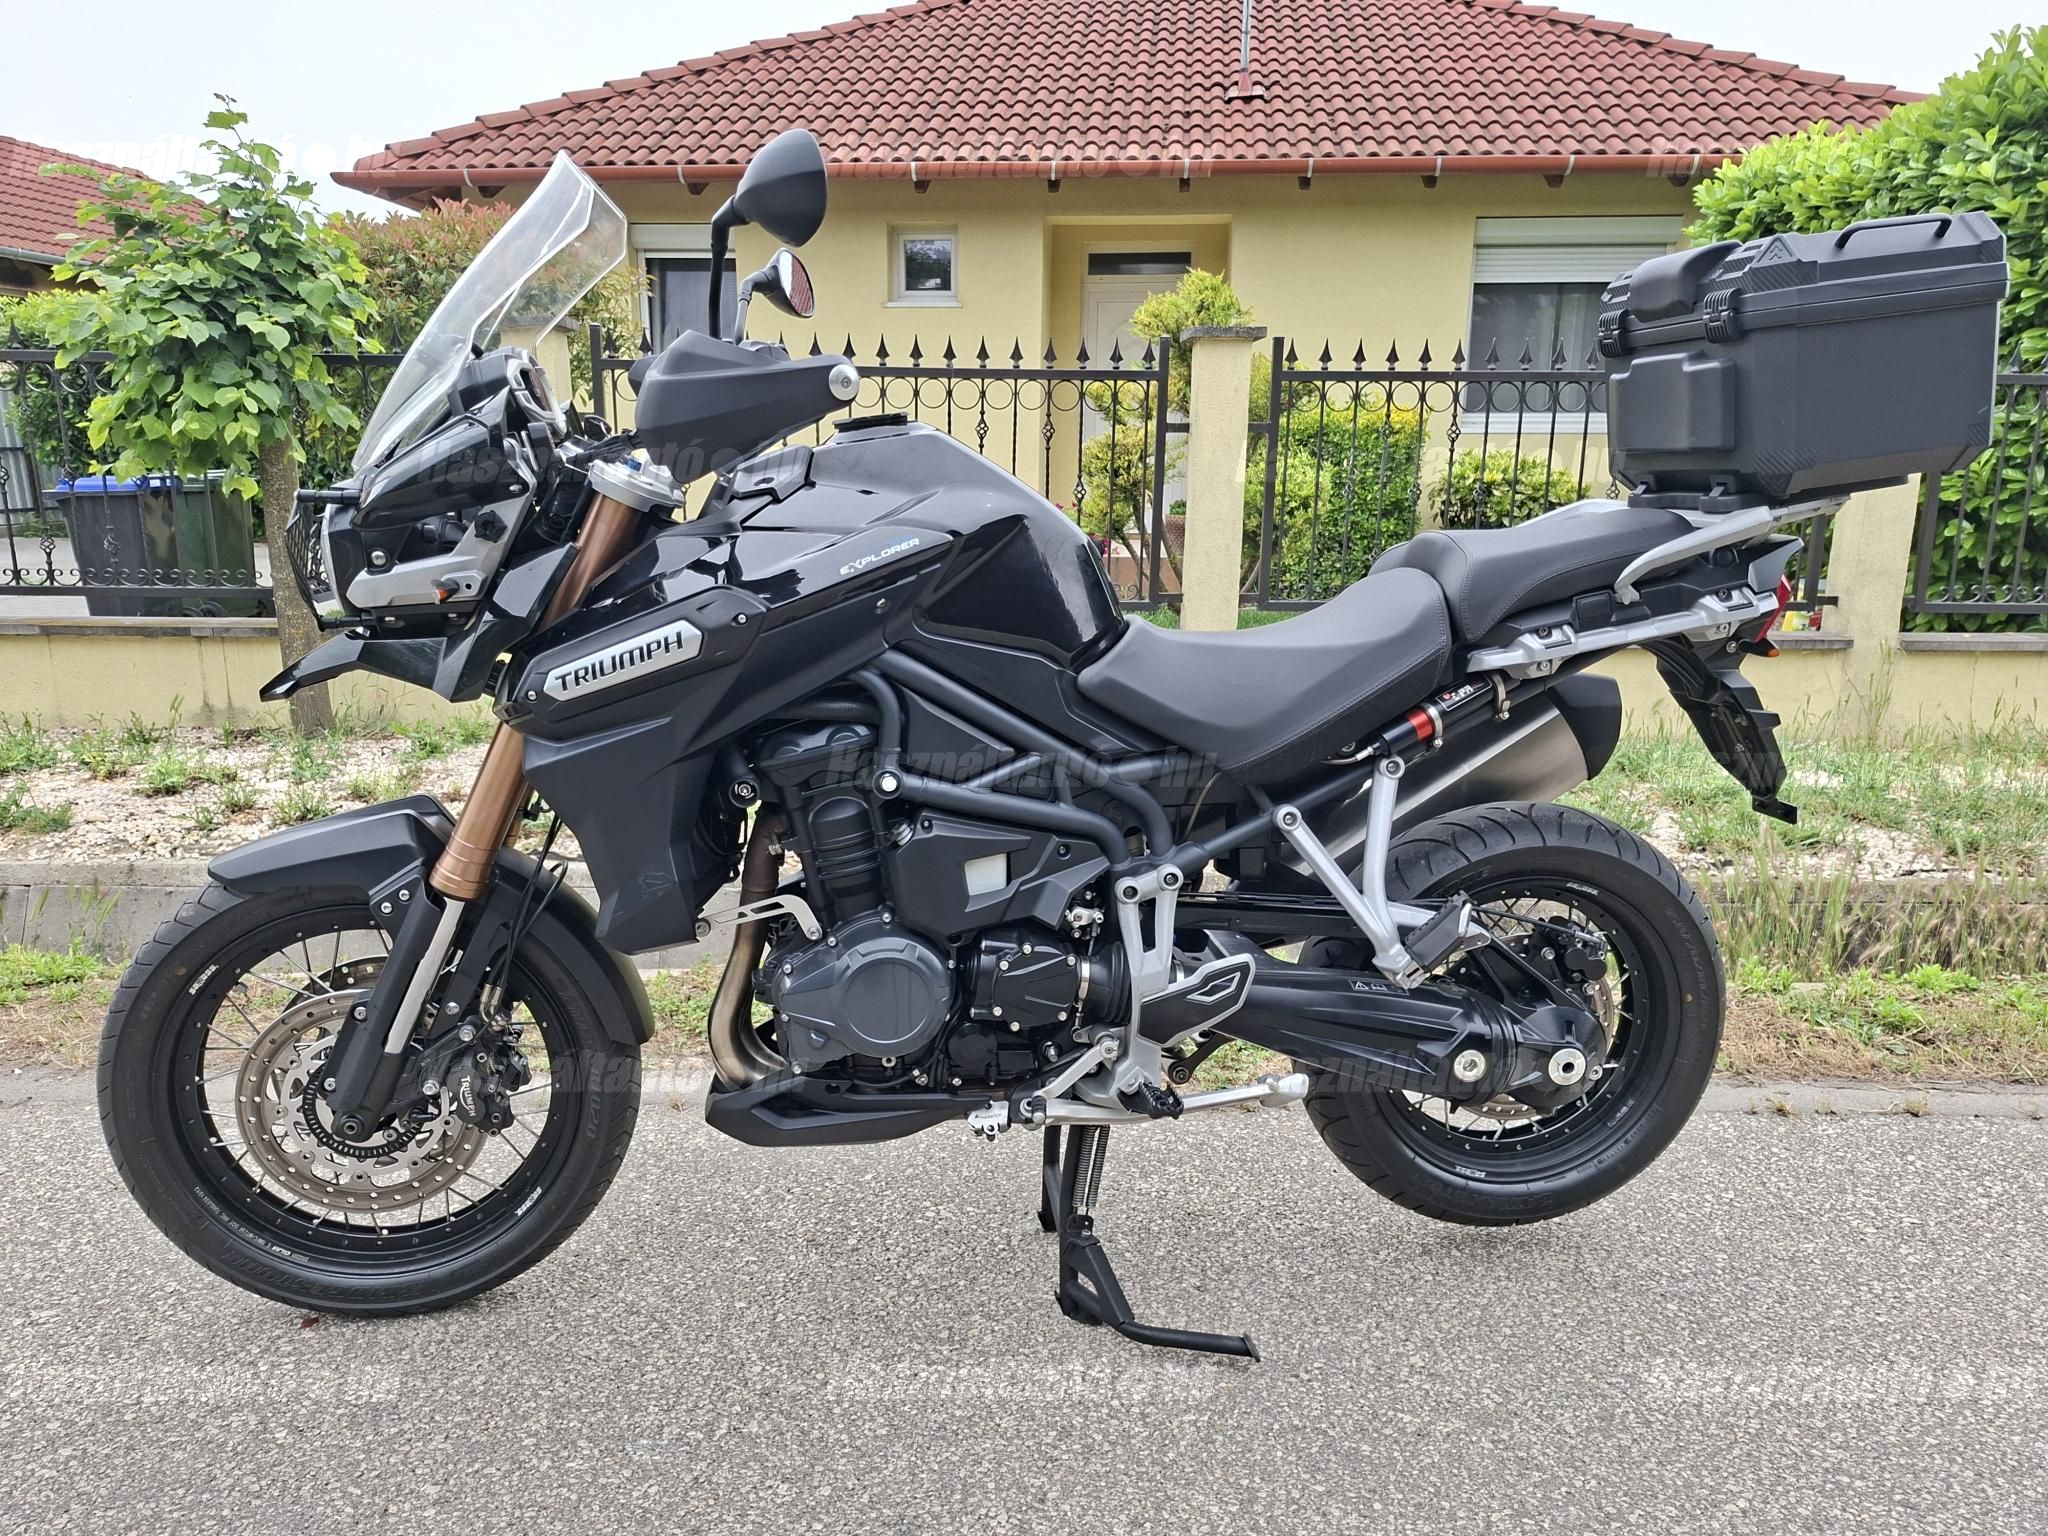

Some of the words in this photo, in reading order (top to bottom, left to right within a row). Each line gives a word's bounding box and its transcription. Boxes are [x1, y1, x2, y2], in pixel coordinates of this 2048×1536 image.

[840, 538, 920, 575] EXPLORER
[555, 630, 683, 692] TRIUMPH
[460, 1075, 477, 1117] TRIUMPH
